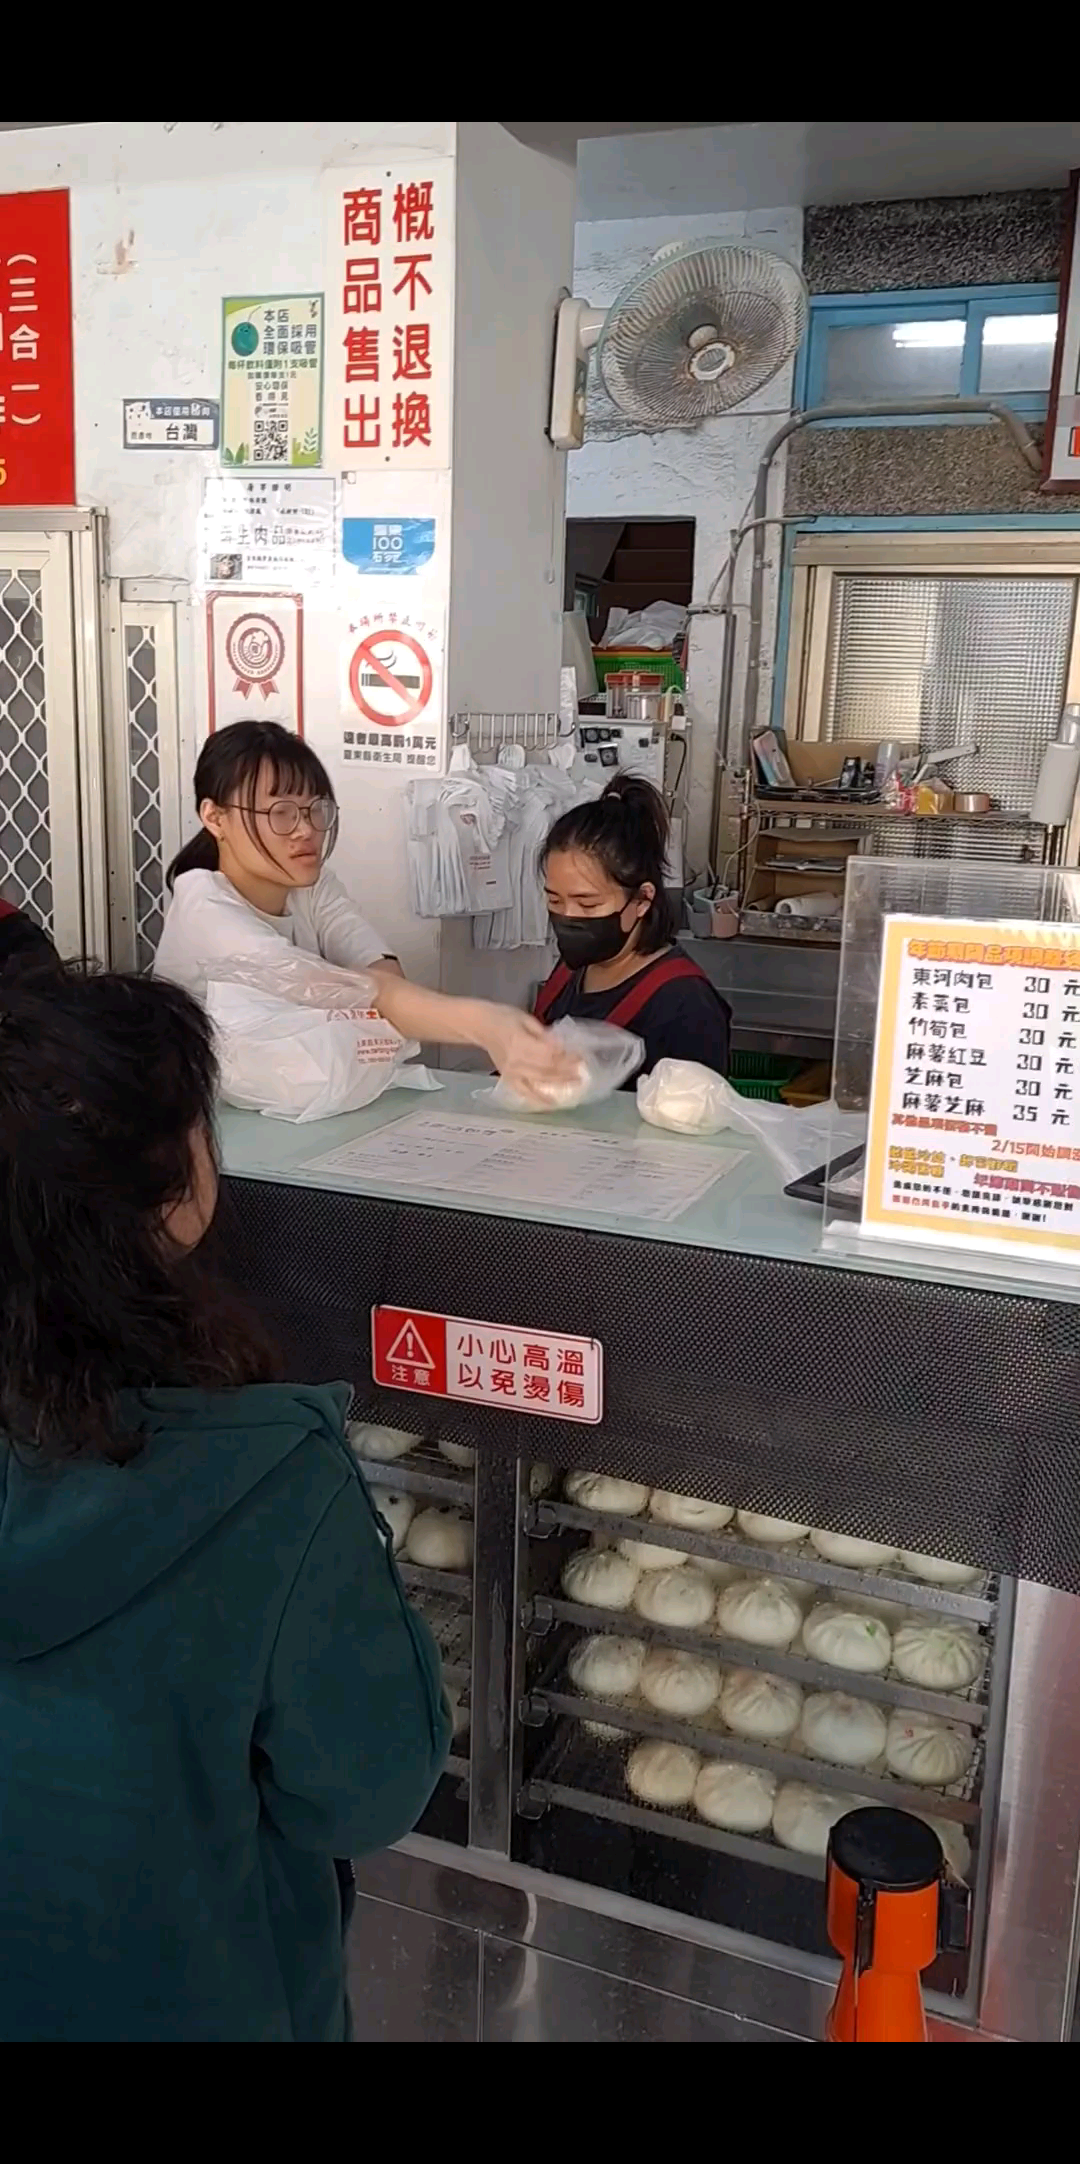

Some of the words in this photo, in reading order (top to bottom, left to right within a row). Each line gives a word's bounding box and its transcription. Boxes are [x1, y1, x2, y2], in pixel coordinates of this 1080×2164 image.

[263, 309, 290, 323] 本店
[342, 187, 382, 449] 商品售出
[263, 324, 318, 340] 全面採用
[263, 341, 318, 356] 環保吸管
[165, 422, 198, 442] 台灣
[372, 536, 404, 551] 100
[912, 968, 994, 990] 東河肉包
[1023, 976, 1050, 994] 30
[1063, 979, 1080, 996] 元
[911, 992, 971, 1014] 素菜包
[1022, 1002, 1049, 1020] 30
[1062, 1006, 1080, 1023] 元
[908, 1016, 968, 1039] 竹筍包
[1018, 1028, 1045, 1046] 30
[1057, 1031, 1077, 1049] 元
[905, 1042, 987, 1067] 麻薯紅豆
[1016, 1054, 1043, 1072] 30
[1055, 1057, 1074, 1074] 元
[904, 1066, 964, 1090] 芝麻包
[1014, 1079, 1042, 1097] 30
[1053, 1083, 1073, 1100] 元
[902, 1091, 986, 1117] 麻薯芝麻
[1012, 1104, 1039, 1122] 35
[1051, 1108, 1071, 1126] 元
[457, 1333, 585, 1377] 小心高溫
[391, 1364, 431, 1387] 注意
[457, 1363, 586, 1408] 以免燙傷
